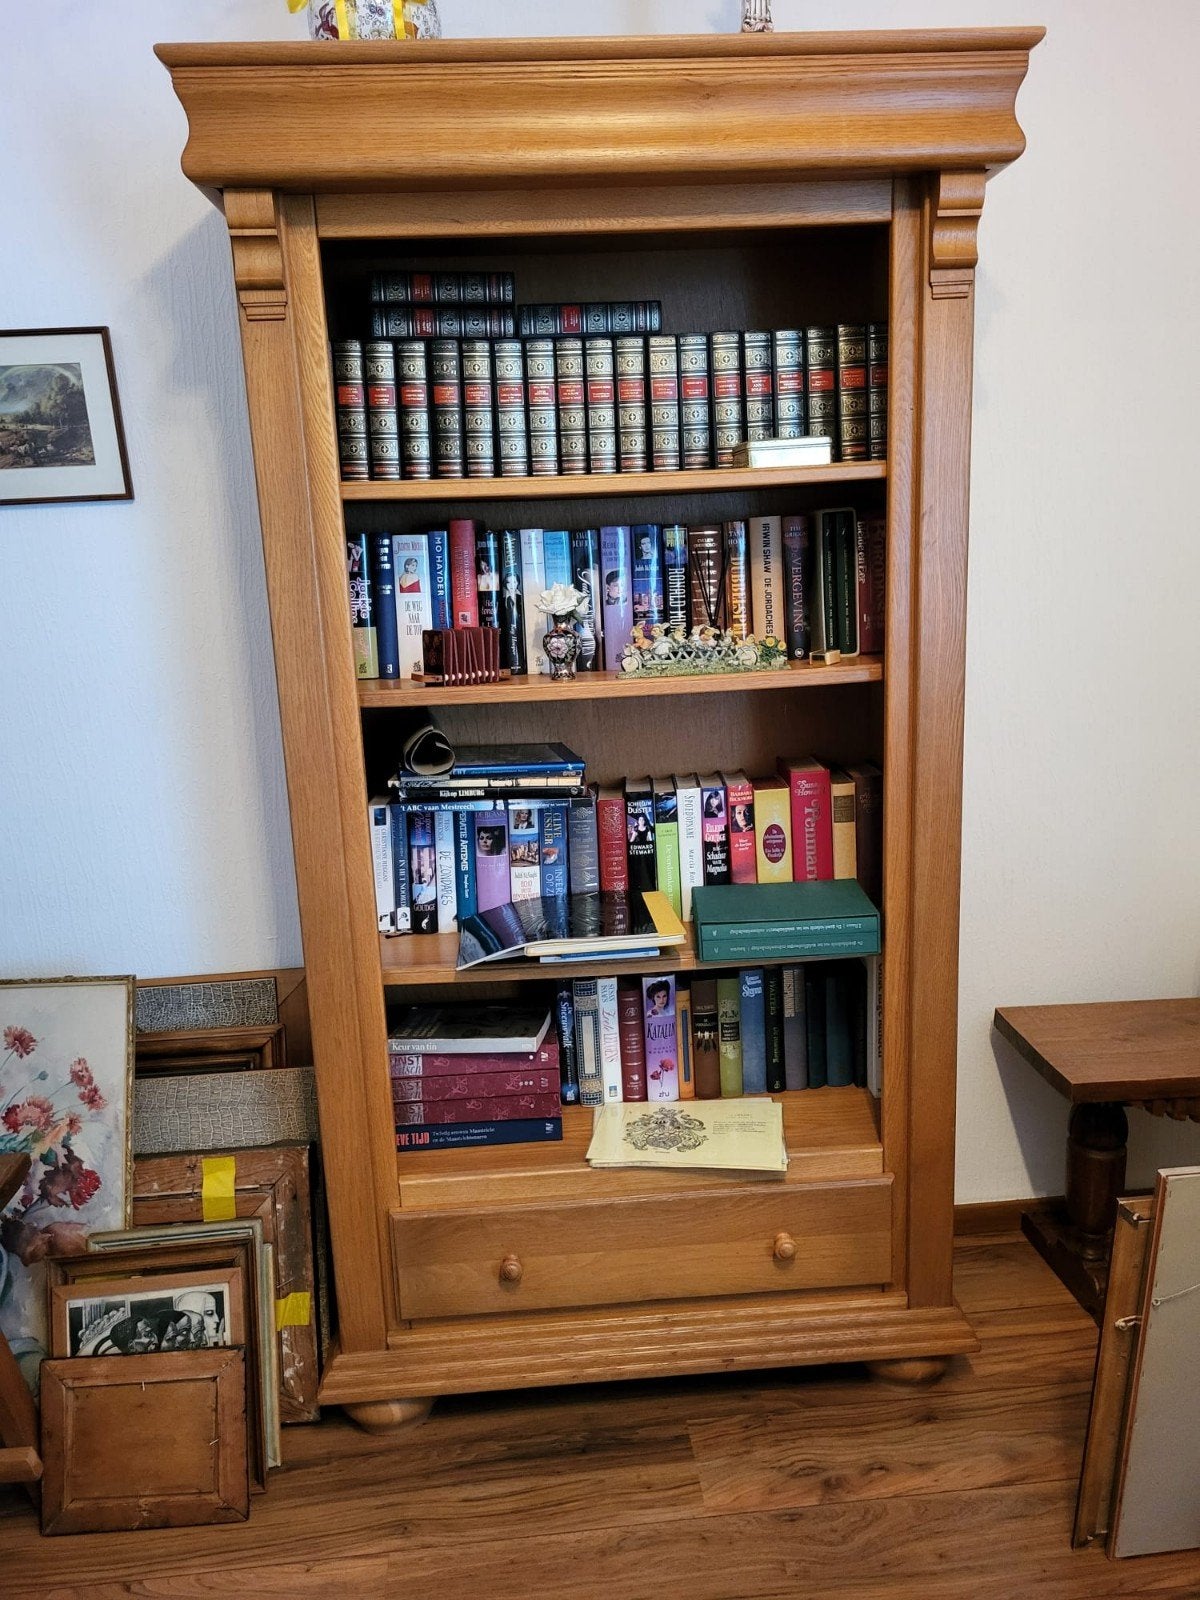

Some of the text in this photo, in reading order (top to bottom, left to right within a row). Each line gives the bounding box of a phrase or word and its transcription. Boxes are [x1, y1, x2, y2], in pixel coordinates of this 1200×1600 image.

[434, 536, 444, 597] MO HAYDER
[762, 523, 774, 634] IRWIN SHAW DE JORDACHES
[356, 577, 371, 619] Jackie
[669, 567, 686, 610] RONALD
[791, 557, 804, 633] VERGEVING
[440, 802, 475, 811] Mestreech
[458, 790, 485, 798] LIMBURG
[460, 810, 469, 871] PERATIE ARTEMIS
[544, 810, 554, 845] USSLER
[552, 810, 562, 834] CLIVE
[804, 799, 820, 880] Penmarr
[391, 1041, 437, 1051] Keur van tin
[560, 1001, 572, 1048] Sneeuwvalk
